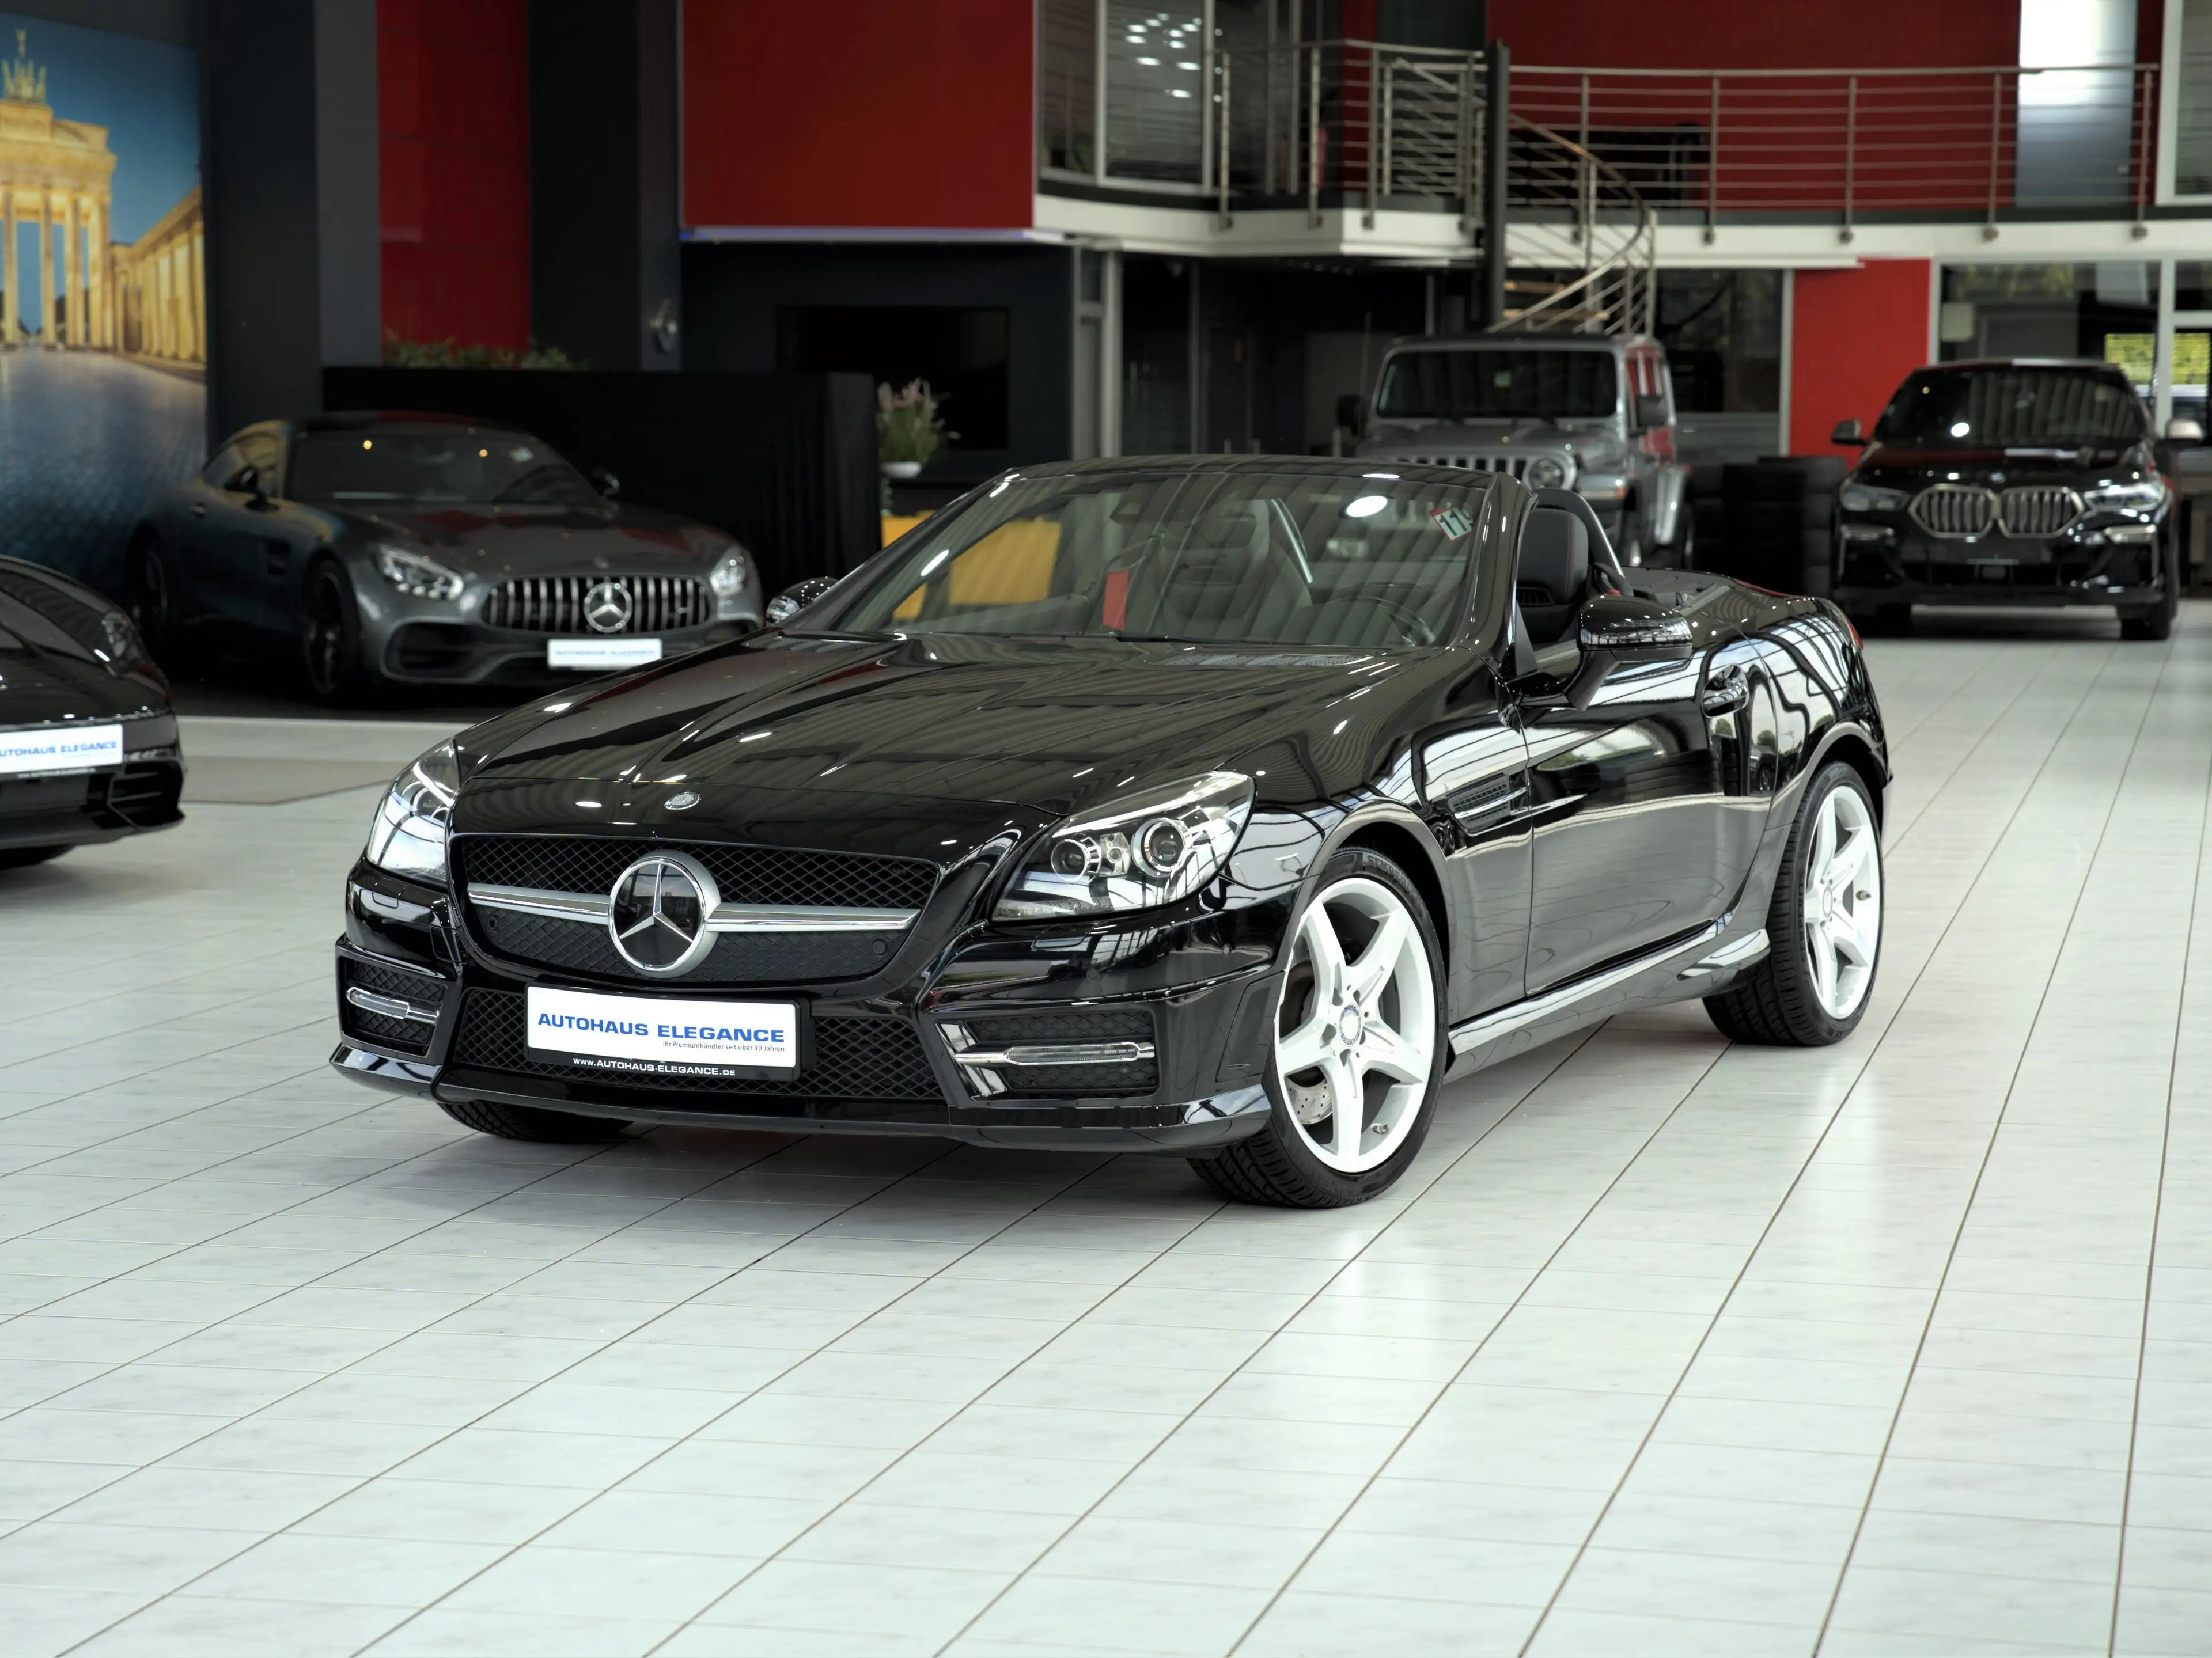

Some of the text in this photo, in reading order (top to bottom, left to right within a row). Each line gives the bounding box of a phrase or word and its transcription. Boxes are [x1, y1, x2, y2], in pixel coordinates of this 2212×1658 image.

[0, 747, 56, 758] UTOHAUS
[60, 741, 116, 753] ELEGANCE
[538, 1013, 784, 1042] AUTOHAUS ELEGANCE
